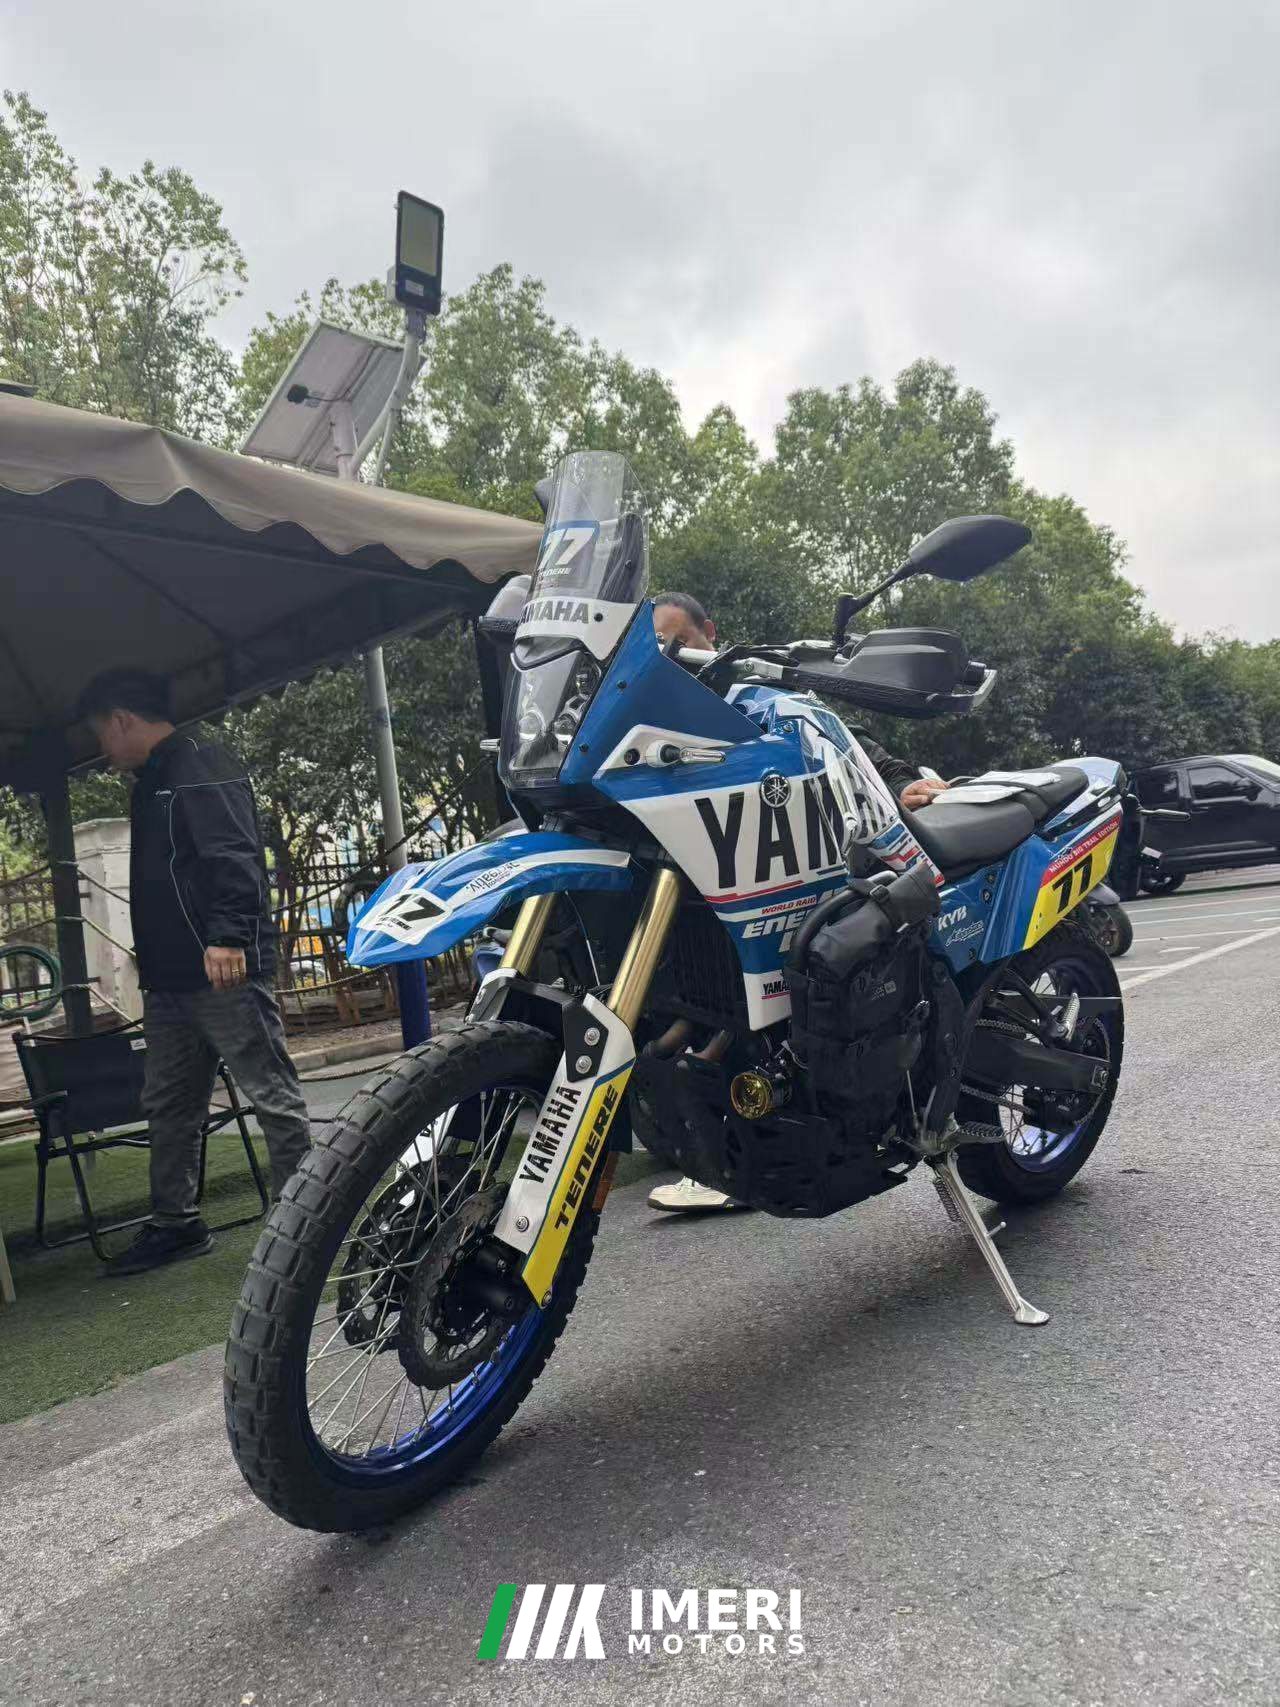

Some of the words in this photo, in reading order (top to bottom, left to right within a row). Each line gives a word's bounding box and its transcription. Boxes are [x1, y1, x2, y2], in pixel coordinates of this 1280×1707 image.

[1052, 853, 1093, 914] 77
[761, 902, 795, 915] WORLD
[795, 896, 817, 908] RAID
[938, 905, 967, 931] KYB
[762, 979, 792, 995] YAMA
[519, 1086, 582, 1184] YAMAHA
[554, 1084, 620, 1230] TENERE
